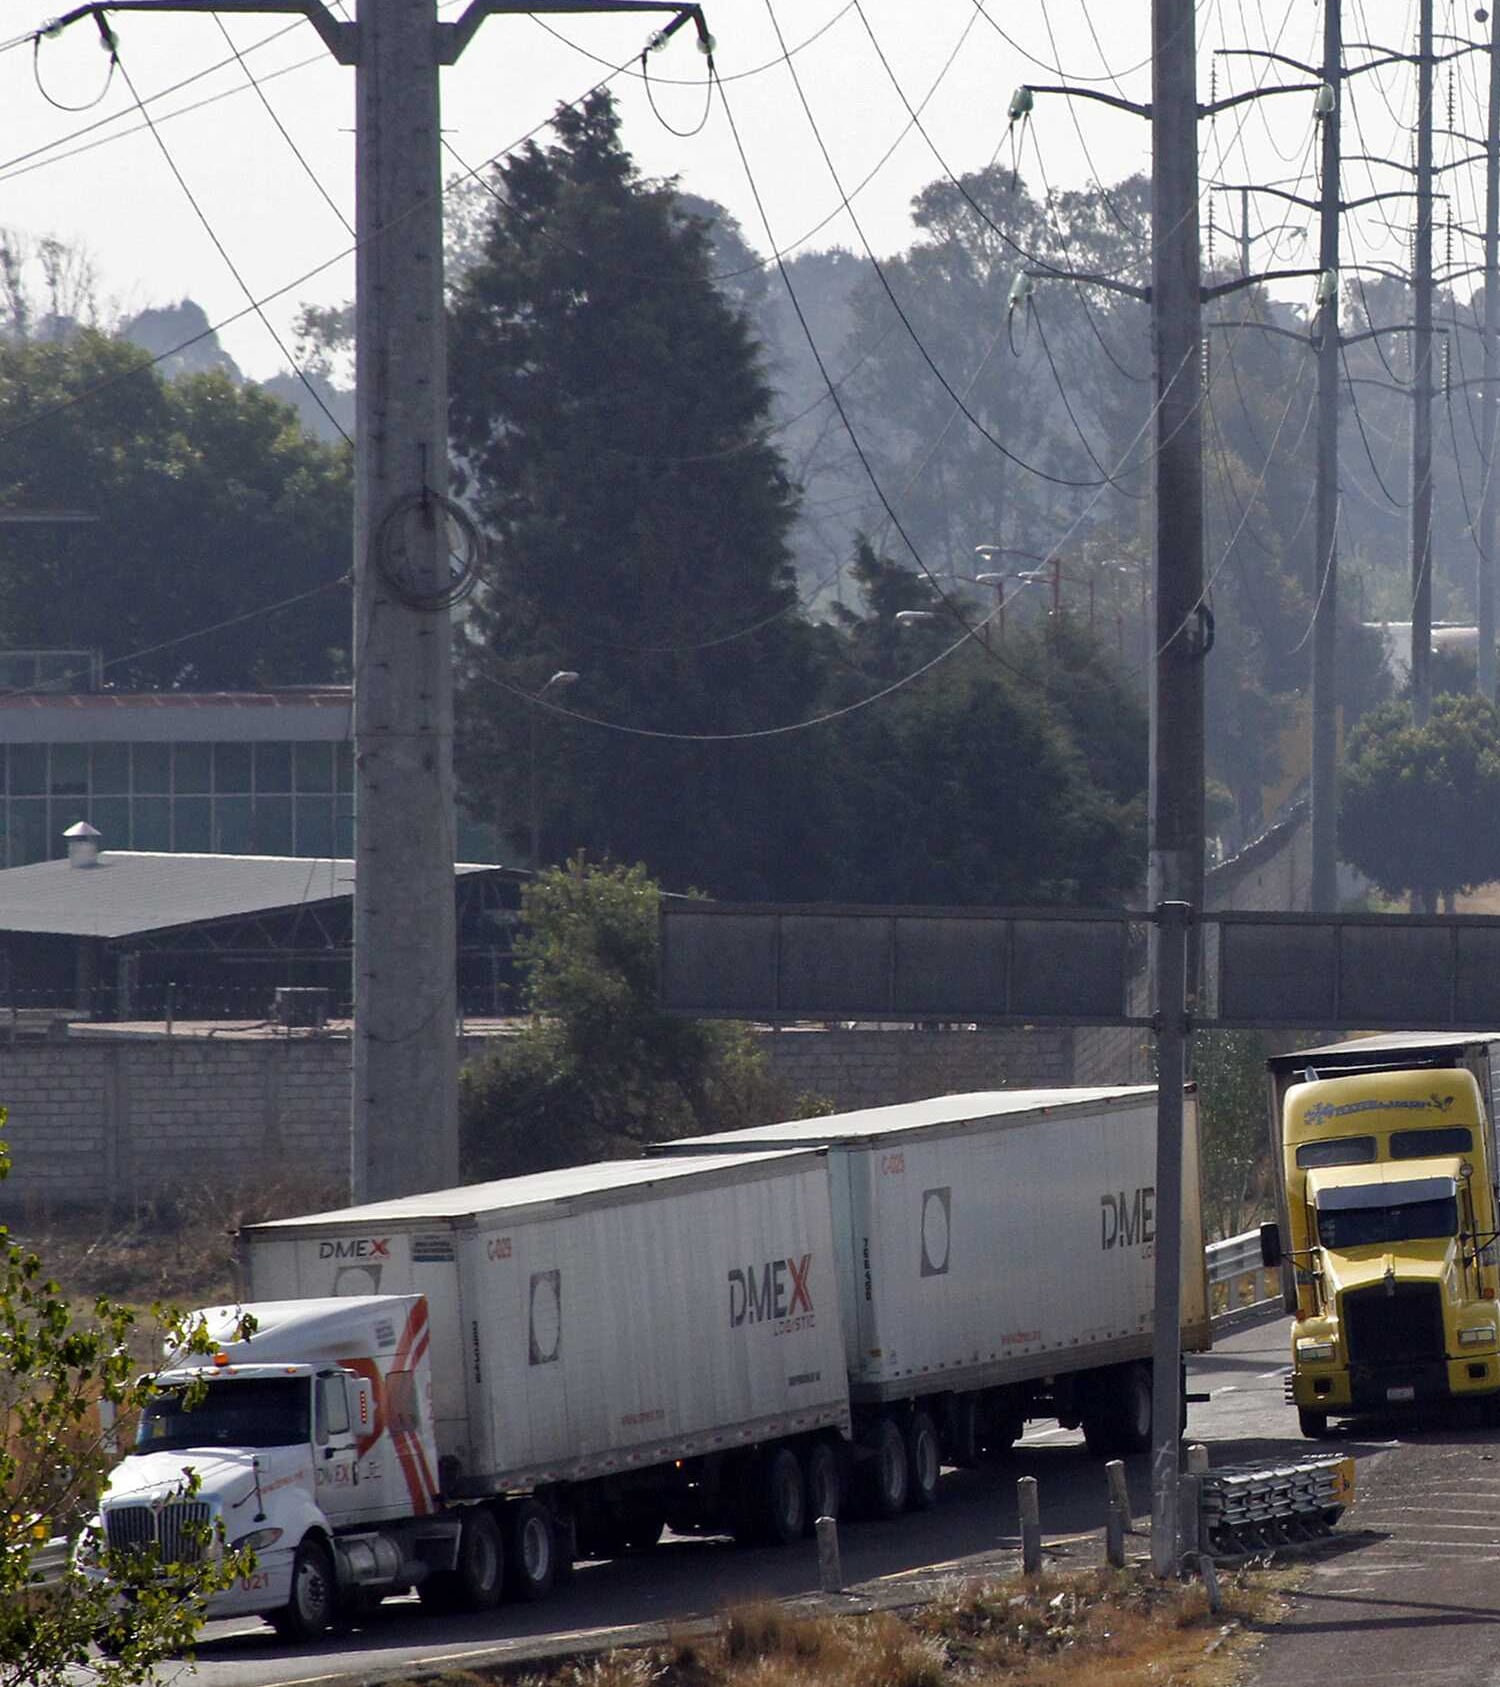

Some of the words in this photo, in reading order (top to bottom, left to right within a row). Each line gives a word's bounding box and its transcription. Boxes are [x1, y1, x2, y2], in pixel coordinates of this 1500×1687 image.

[319, 1238, 392, 1259] DMEX
[1101, 1187, 1157, 1250] DME
[728, 1253, 814, 1329] DMEX
